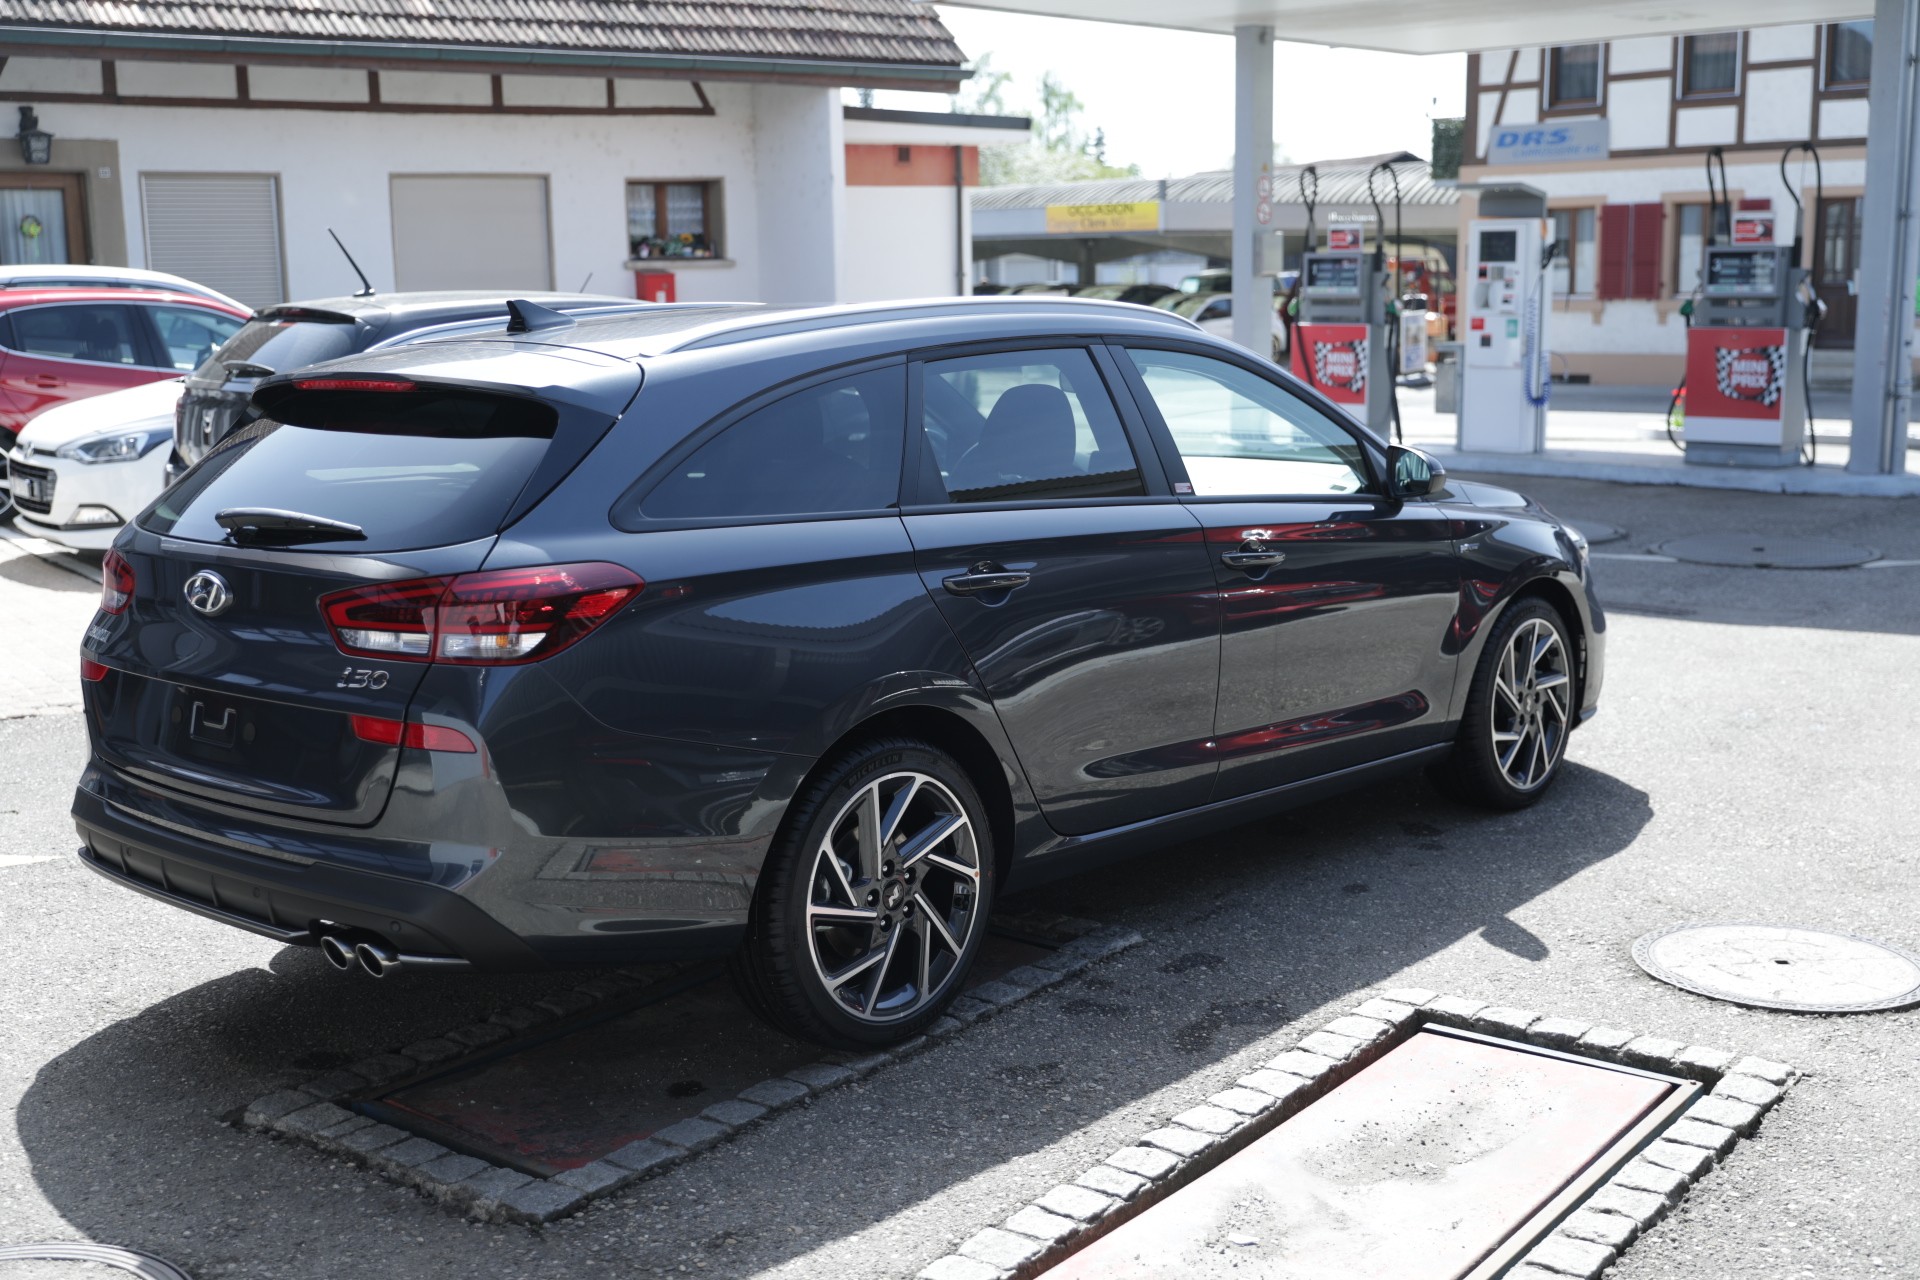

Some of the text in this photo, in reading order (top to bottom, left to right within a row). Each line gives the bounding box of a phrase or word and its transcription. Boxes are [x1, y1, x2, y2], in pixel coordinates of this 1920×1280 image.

[1496, 127, 1568, 149] DRS
[1067, 203, 1135, 216] OCCASION
[1326, 352, 1355, 363] MINI
[1326, 364, 1354, 377] PRIX
[1731, 360, 1769, 373] MINI
[1730, 374, 1768, 389] PRIX
[337, 667, 390, 690] i30
[847, 754, 900, 787] MICHELIN
